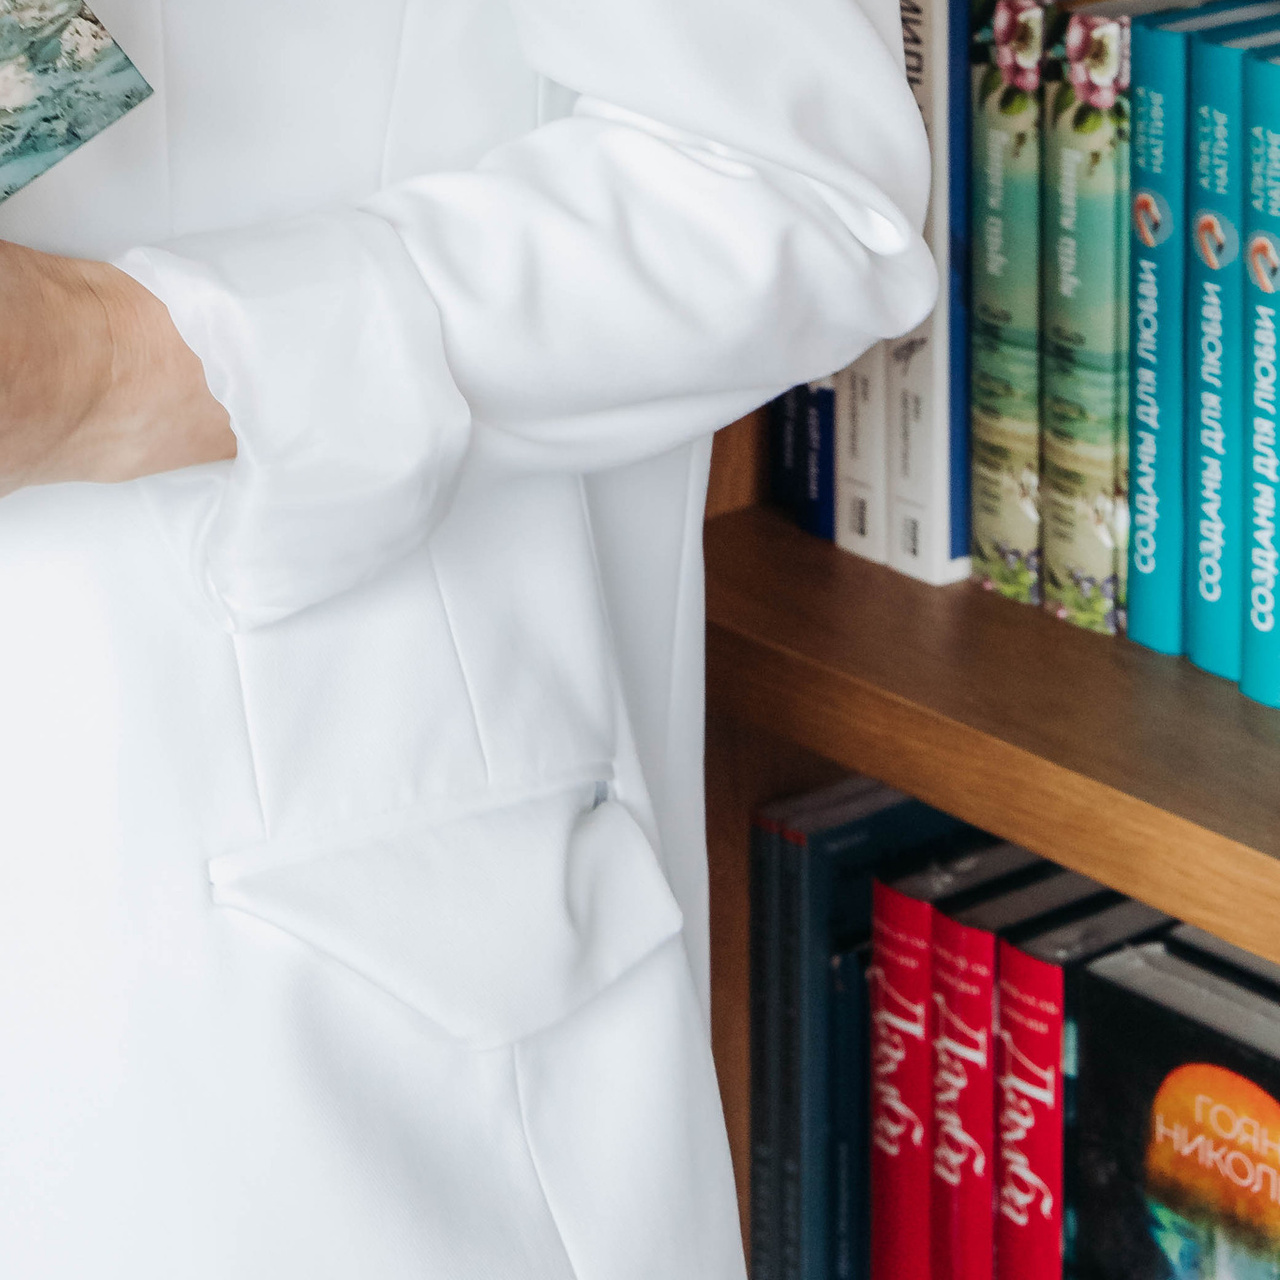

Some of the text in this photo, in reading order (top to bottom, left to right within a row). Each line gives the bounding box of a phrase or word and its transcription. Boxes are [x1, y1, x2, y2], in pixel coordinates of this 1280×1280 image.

[1133, 259, 1160, 574] СОЗДАНЫ ДЛЯ ЛЮБВИ
[1199, 281, 1227, 602] СОЗДАНЫ ДЛЯ ЛЮБВИ
[1250, 304, 1278, 633] СОЗДАНЫ ДЛЯ ЛЮБВИ
